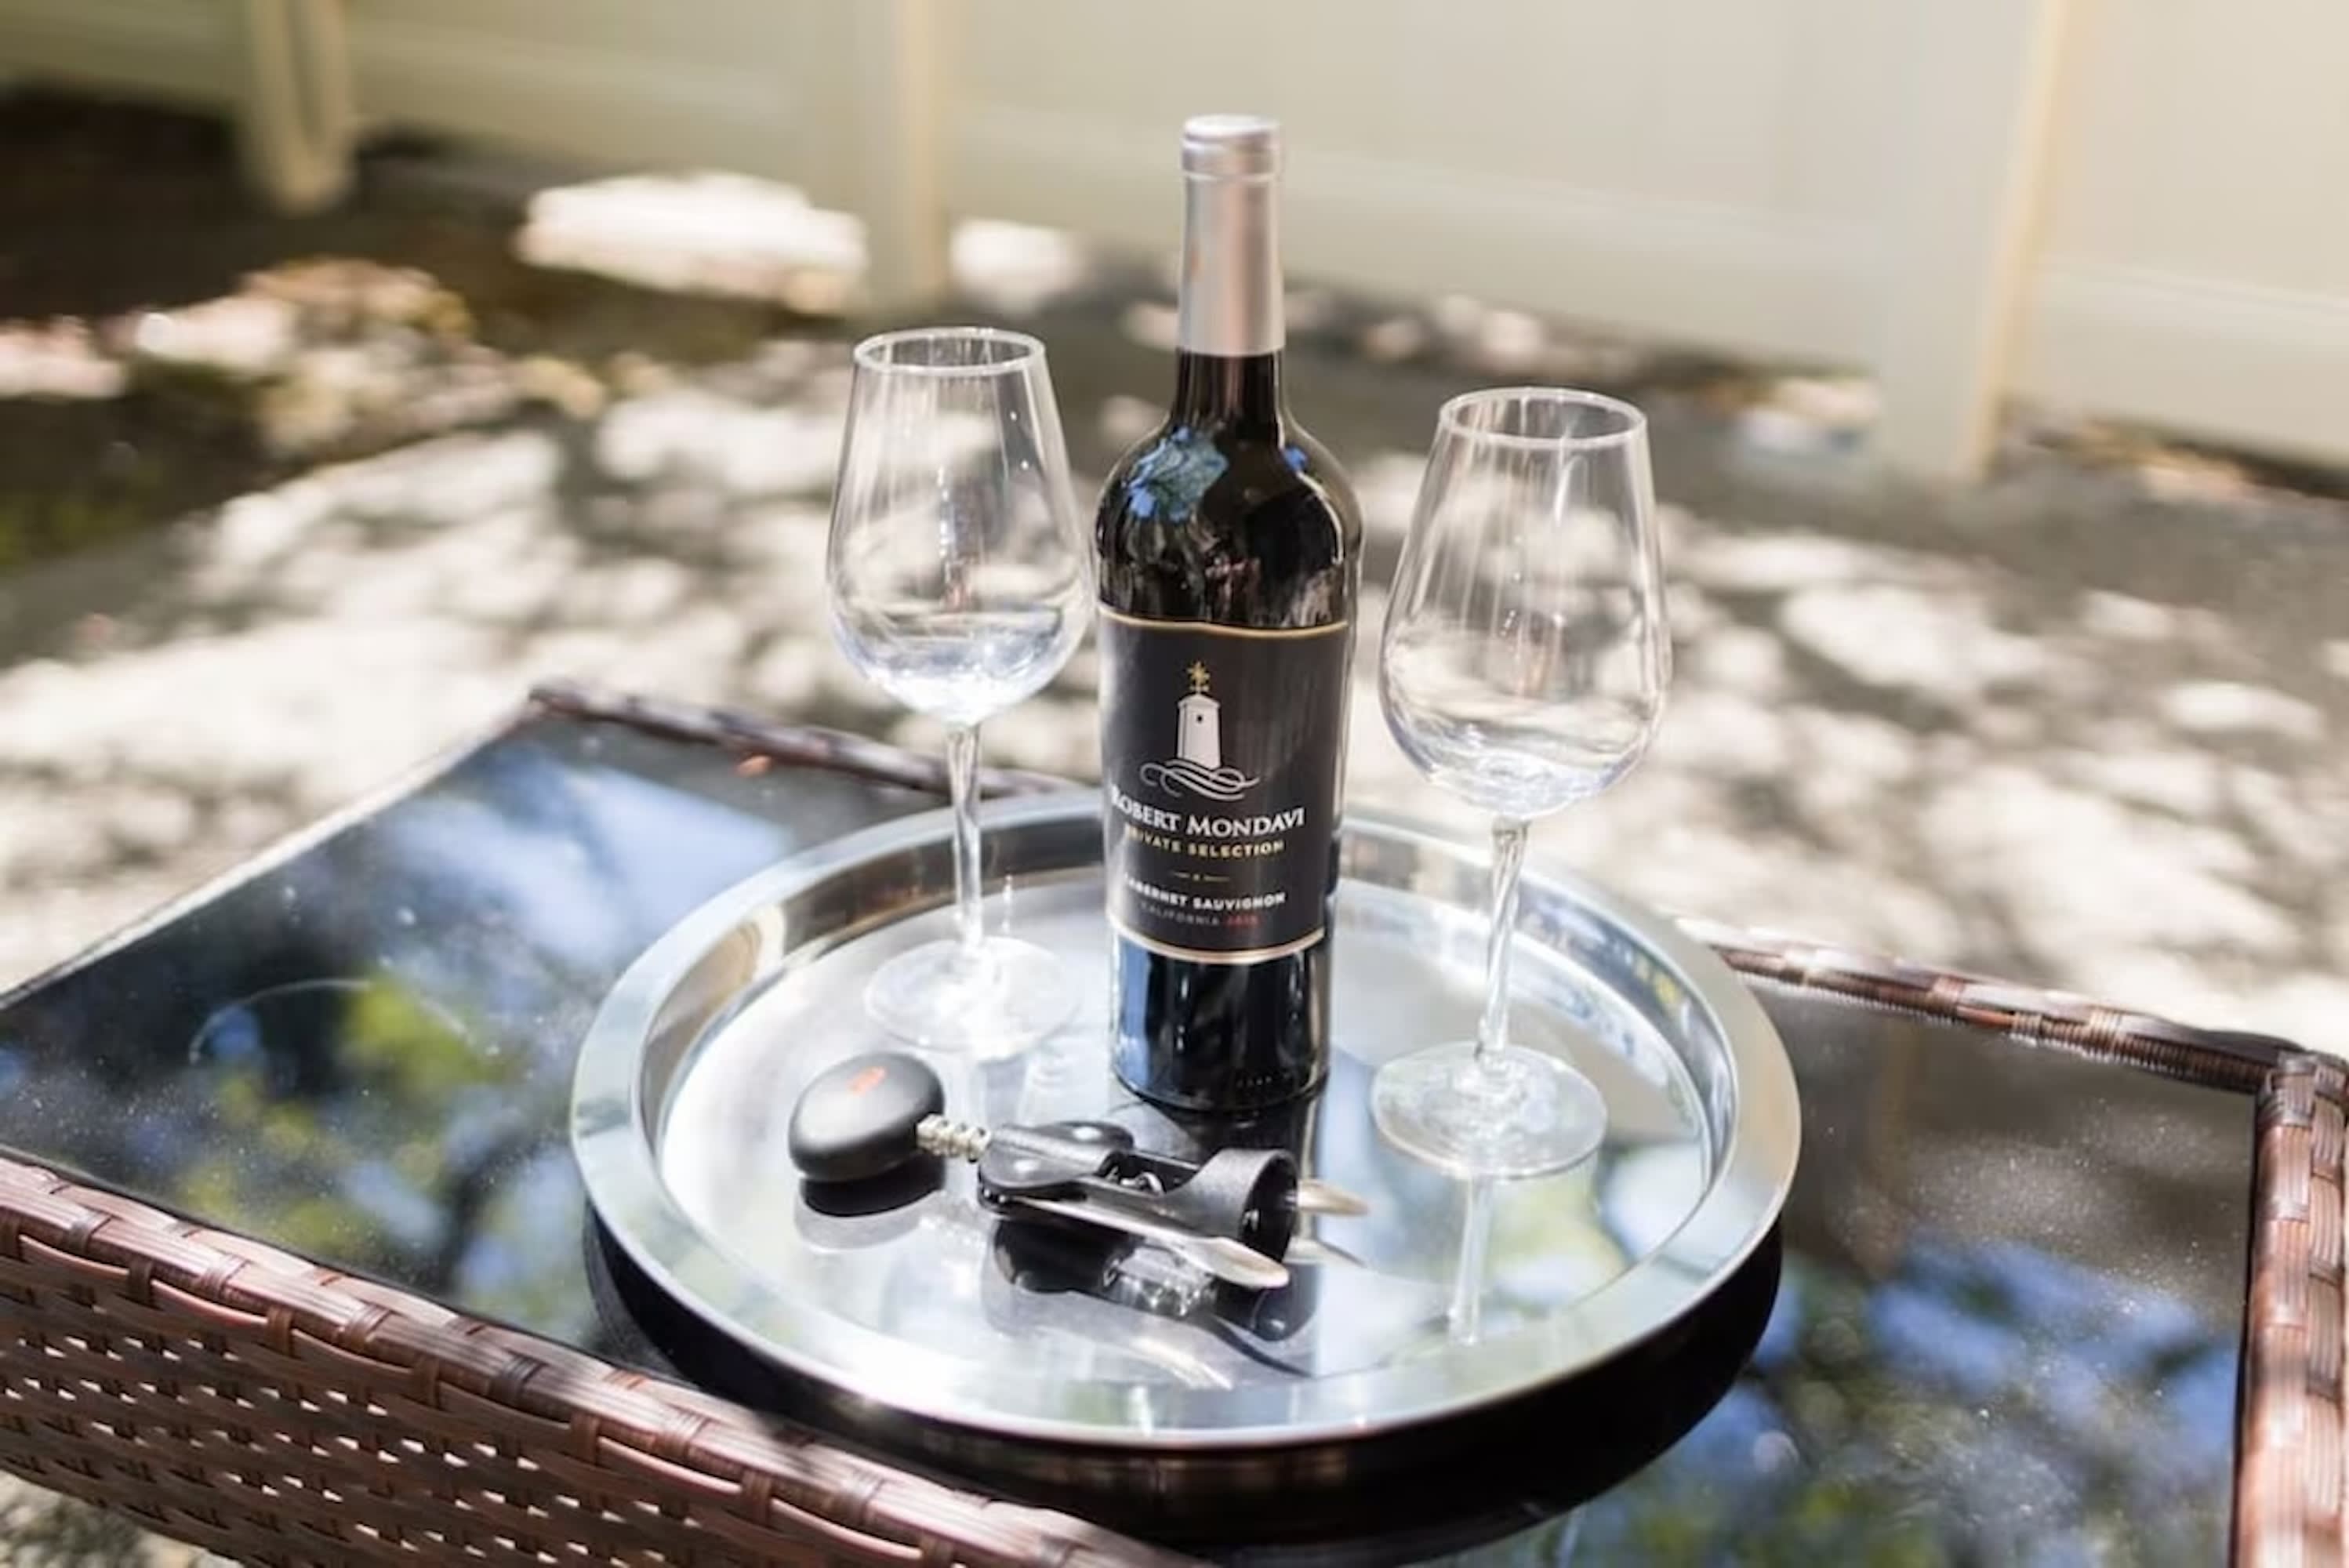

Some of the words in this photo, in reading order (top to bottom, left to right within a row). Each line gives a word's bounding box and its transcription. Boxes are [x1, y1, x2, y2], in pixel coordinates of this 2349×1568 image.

[1185, 807, 1305, 838] MONDAVI
[1187, 839, 1285, 858] SELECTION
[1193, 891, 1286, 911] SAUVIGNON
